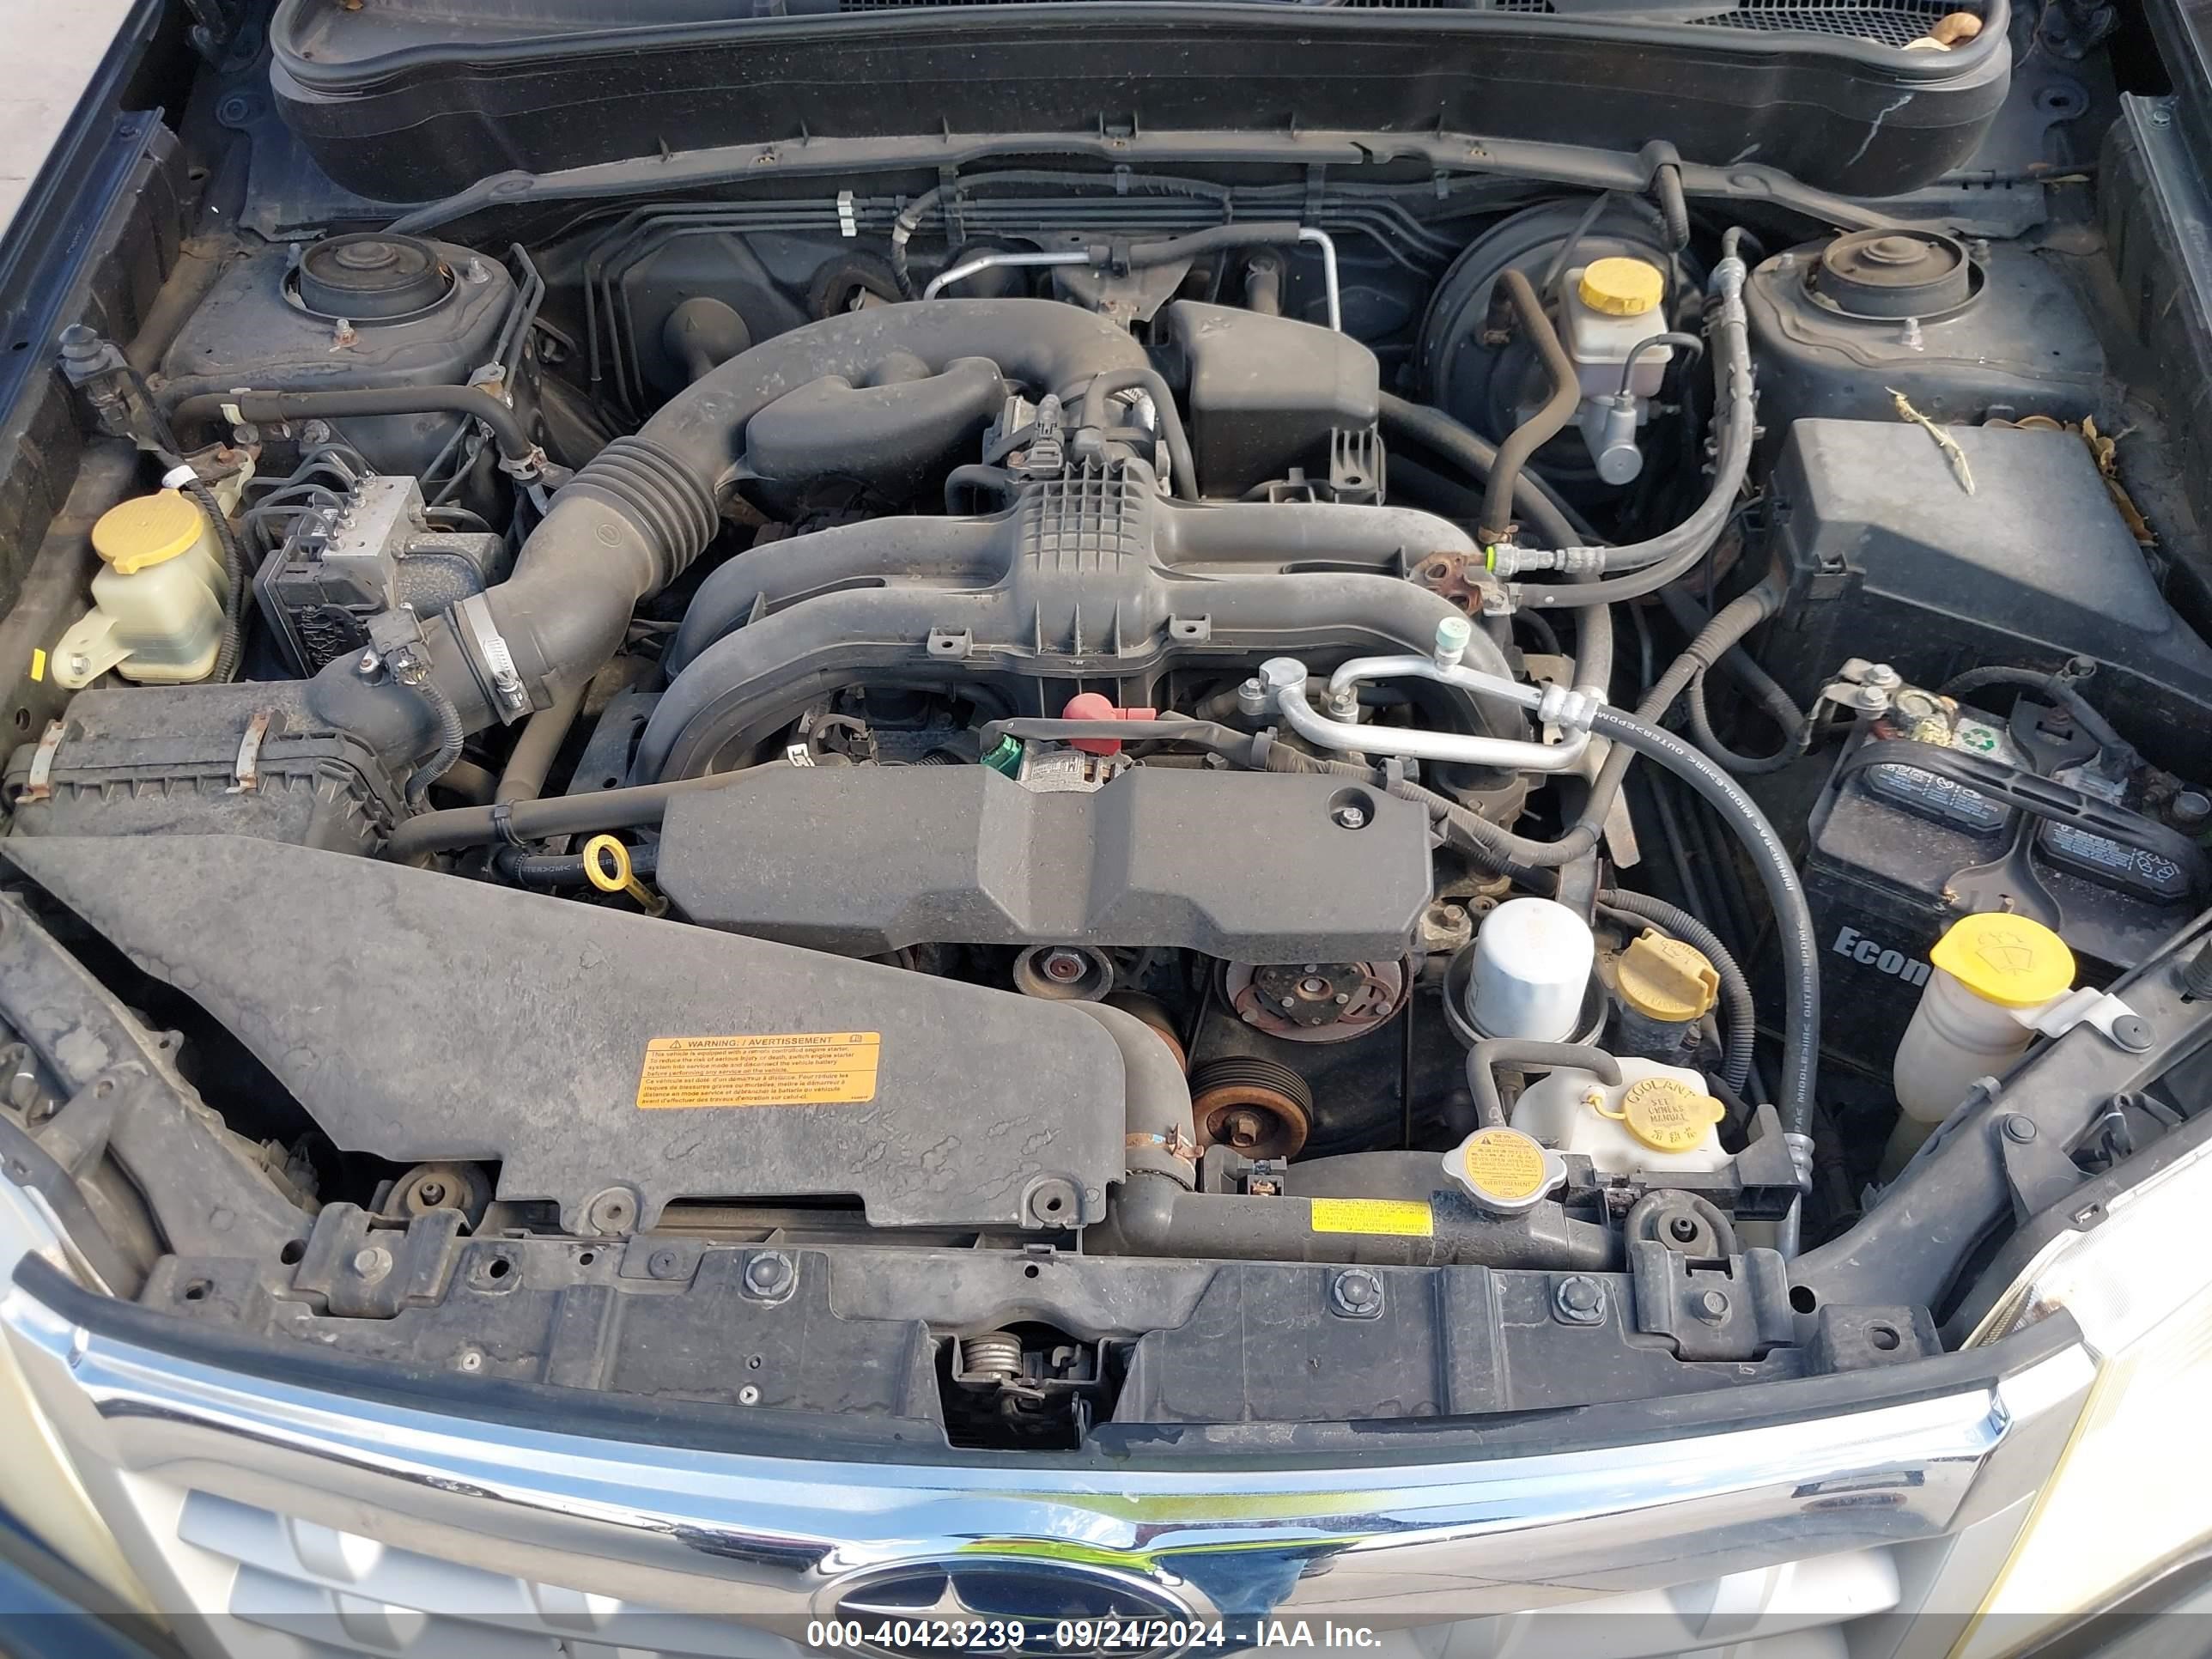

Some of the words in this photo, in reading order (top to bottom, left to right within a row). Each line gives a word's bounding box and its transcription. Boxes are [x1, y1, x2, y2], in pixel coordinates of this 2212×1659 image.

[1595, 712, 1684, 756] OUTER>EPDM
[748, 1036, 833, 1046] AVERTISSEMENT
[1627, 1080, 1696, 1103] COOLANT
[1650, 1113, 1687, 1122] MANUAL
